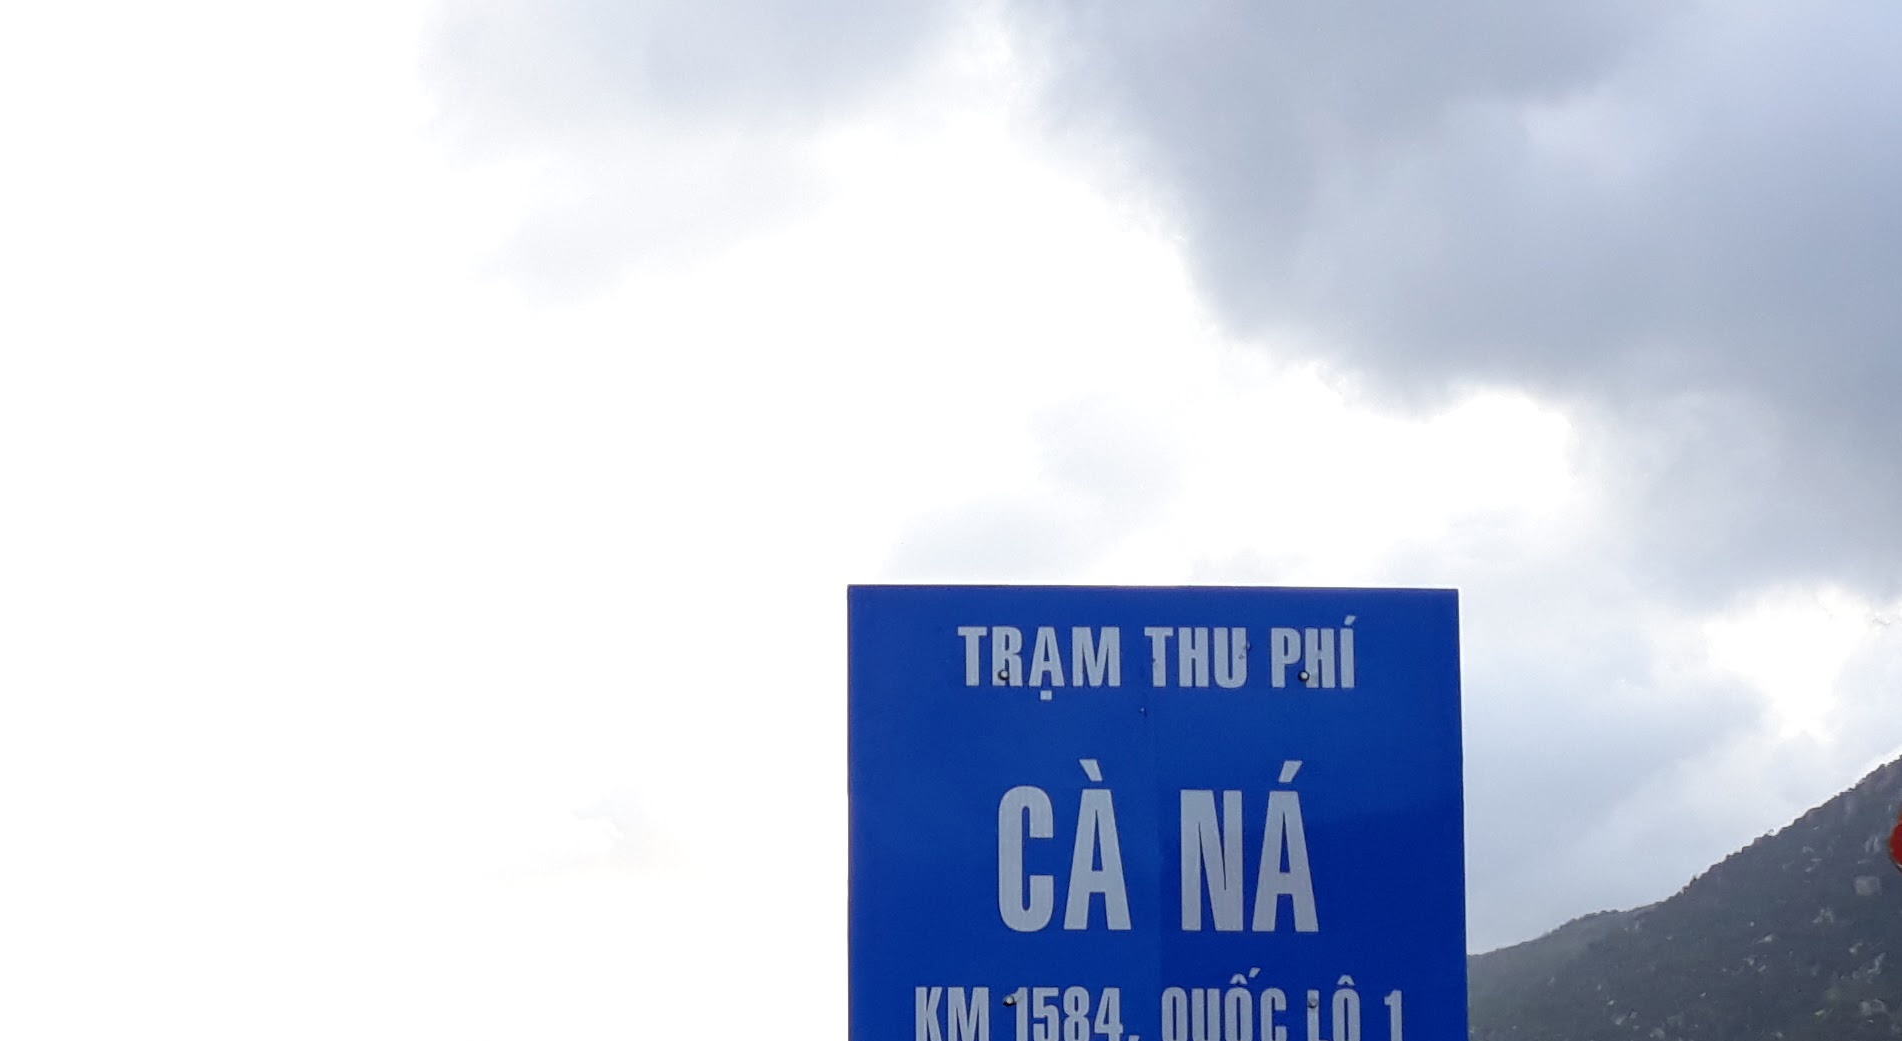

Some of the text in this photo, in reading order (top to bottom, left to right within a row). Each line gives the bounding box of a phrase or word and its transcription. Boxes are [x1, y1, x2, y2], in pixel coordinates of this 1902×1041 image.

[958, 615, 1356, 701] TRẠM THU PHÍ
[998, 759, 1319, 932] CÀ NÁ
